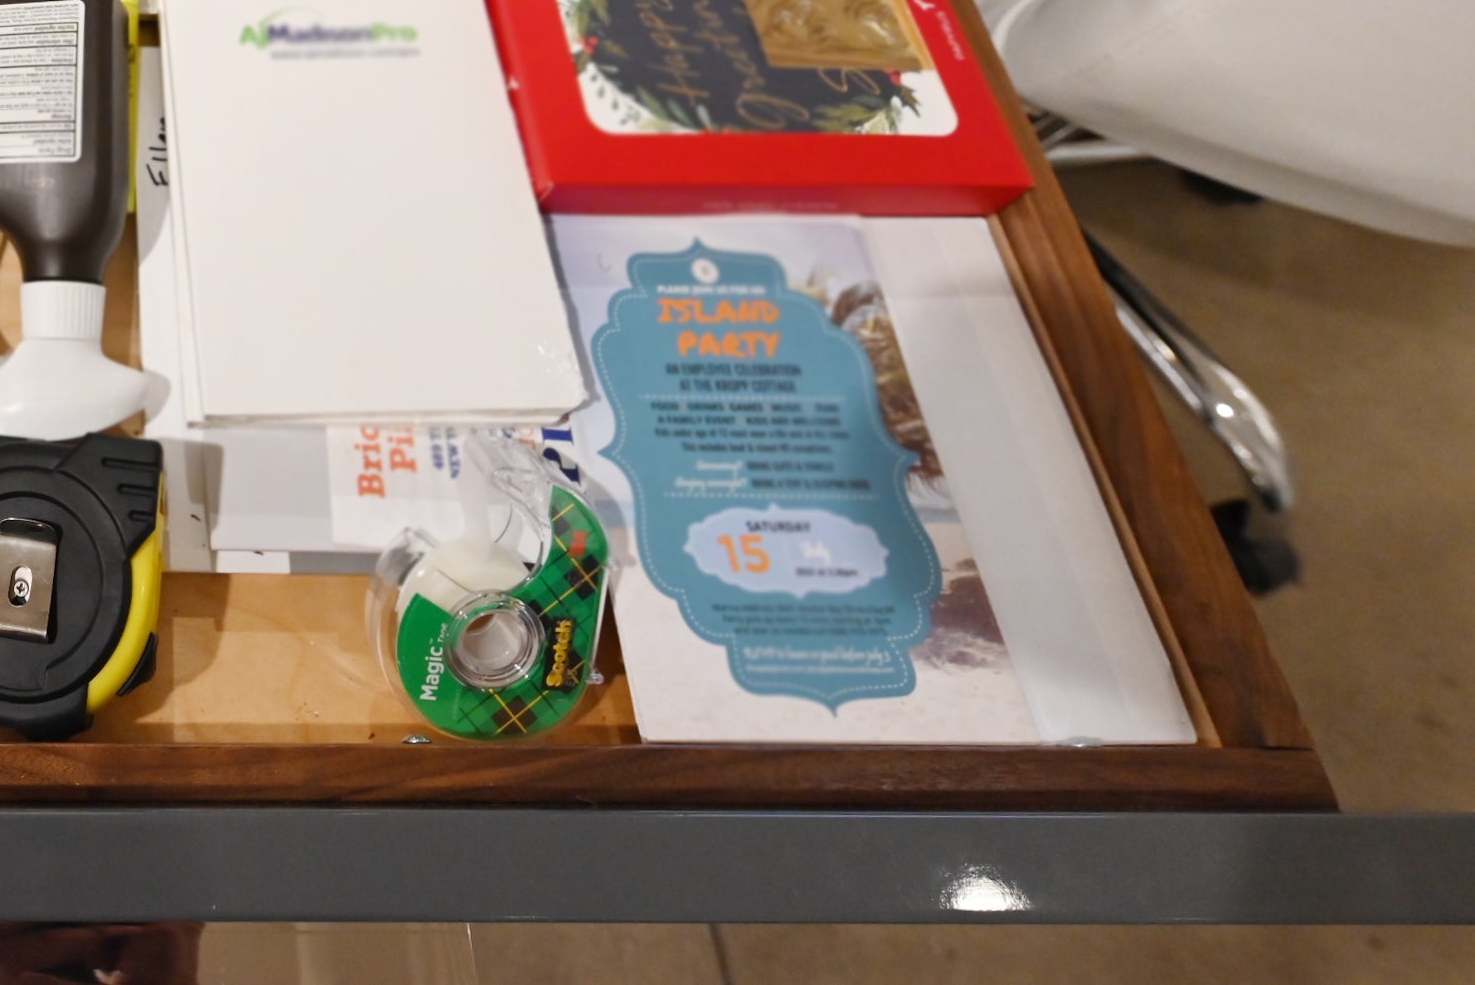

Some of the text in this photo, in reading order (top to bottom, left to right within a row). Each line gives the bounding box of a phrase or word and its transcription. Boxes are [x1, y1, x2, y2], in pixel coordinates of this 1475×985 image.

[657, 298, 781, 325] ISLAND
[677, 330, 781, 358] PARTY
[745, 520, 811, 533] SATURDAY
[717, 534, 771, 574] 15
[546, 618, 574, 688] Scotch
[420, 645, 445, 702] Magic
